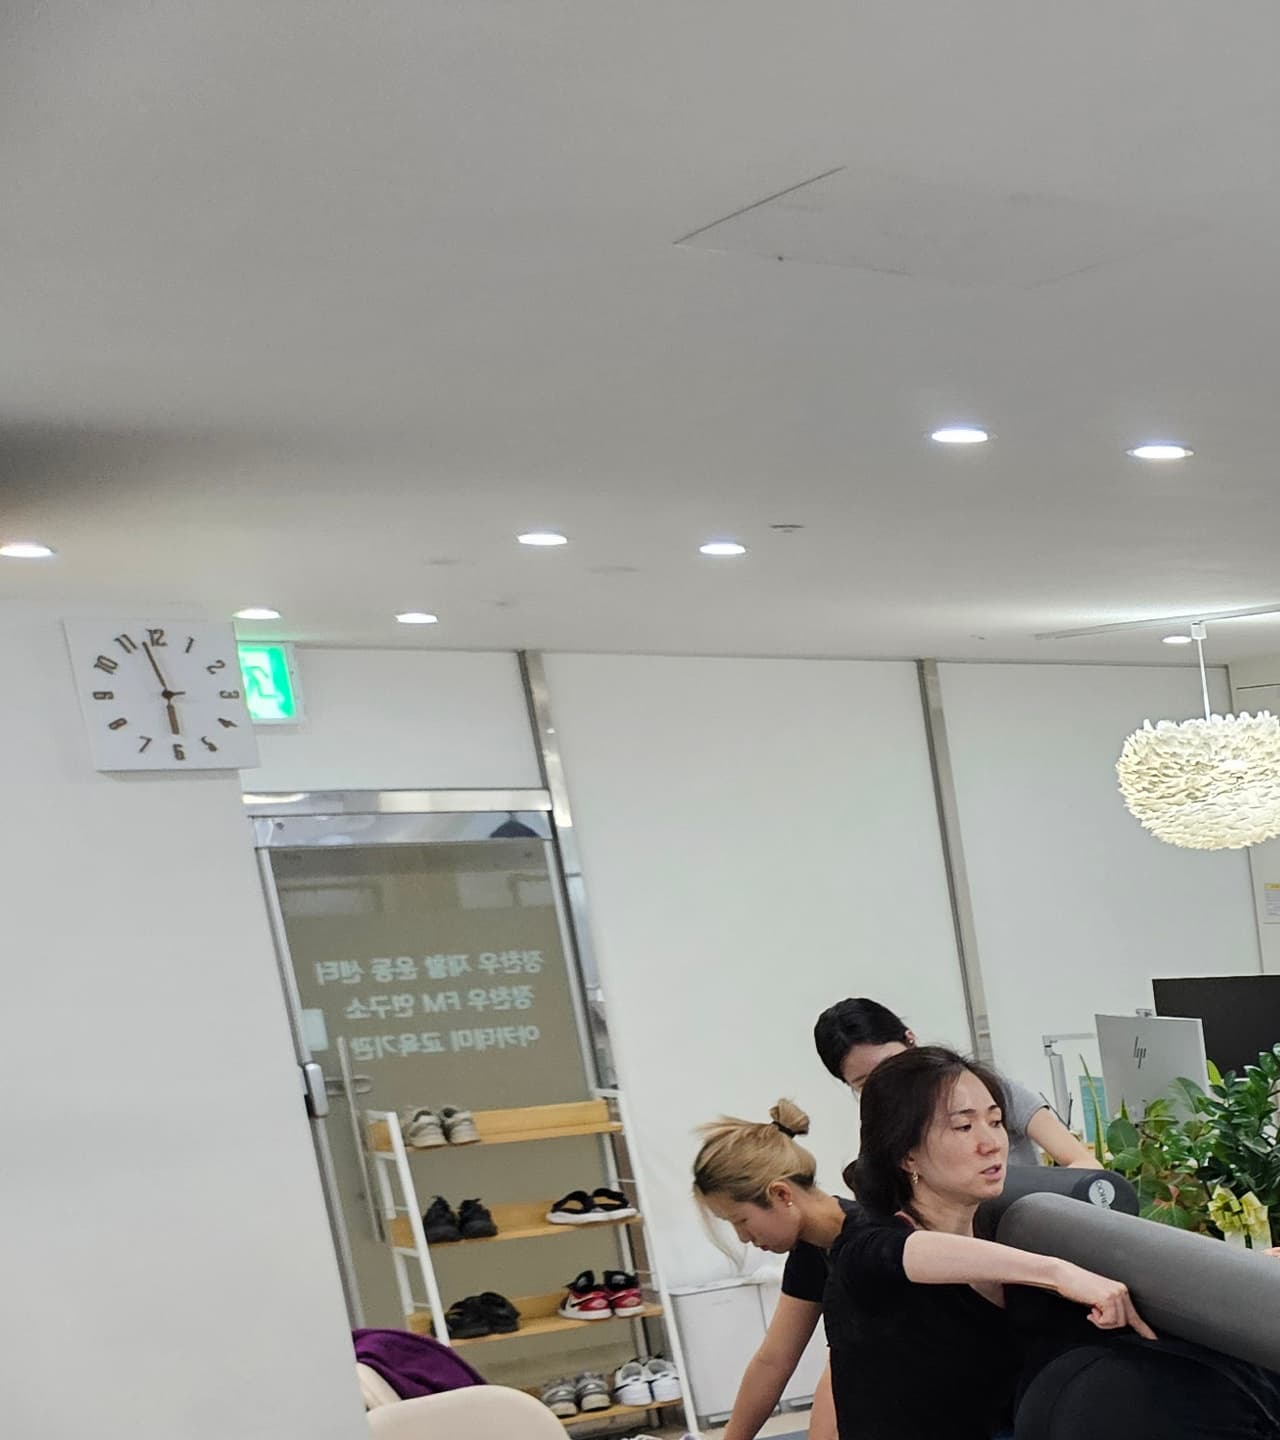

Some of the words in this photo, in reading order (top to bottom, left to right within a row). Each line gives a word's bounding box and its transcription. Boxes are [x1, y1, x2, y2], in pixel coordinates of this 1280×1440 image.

[114, 634, 138, 654] 11
[146, 628, 168, 647] 12
[184, 636, 195, 653] 1
[93, 655, 118, 675] 10
[206, 659, 226, 675] 2
[219, 690, 240, 699] 3
[138, 735, 153, 753] 7
[172, 743, 186, 761] 6
